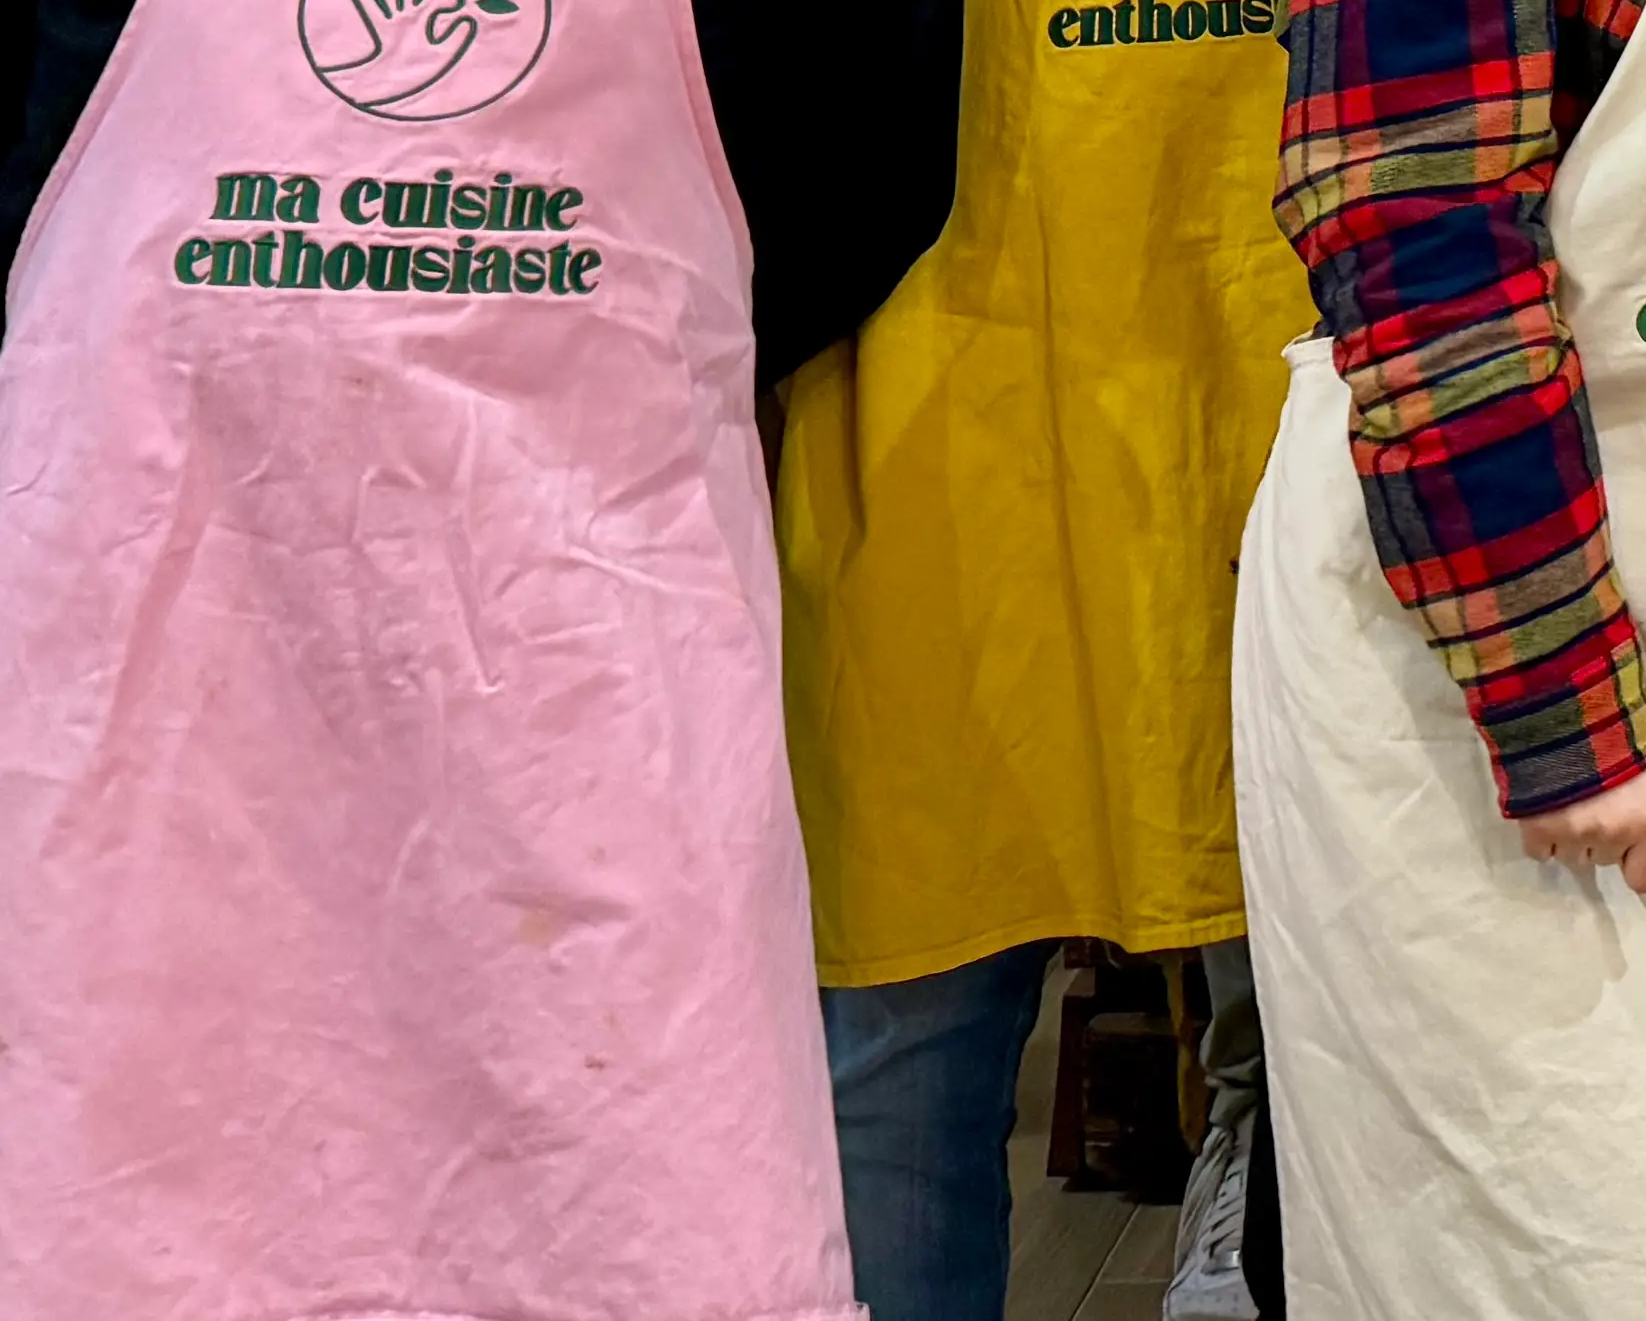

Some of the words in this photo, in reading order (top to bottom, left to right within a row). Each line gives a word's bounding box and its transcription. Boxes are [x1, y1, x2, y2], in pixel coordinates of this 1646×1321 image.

[209, 171, 319, 224] ma
[340, 168, 584, 231] cuisine
[173, 232, 602, 296] enthousiaste
